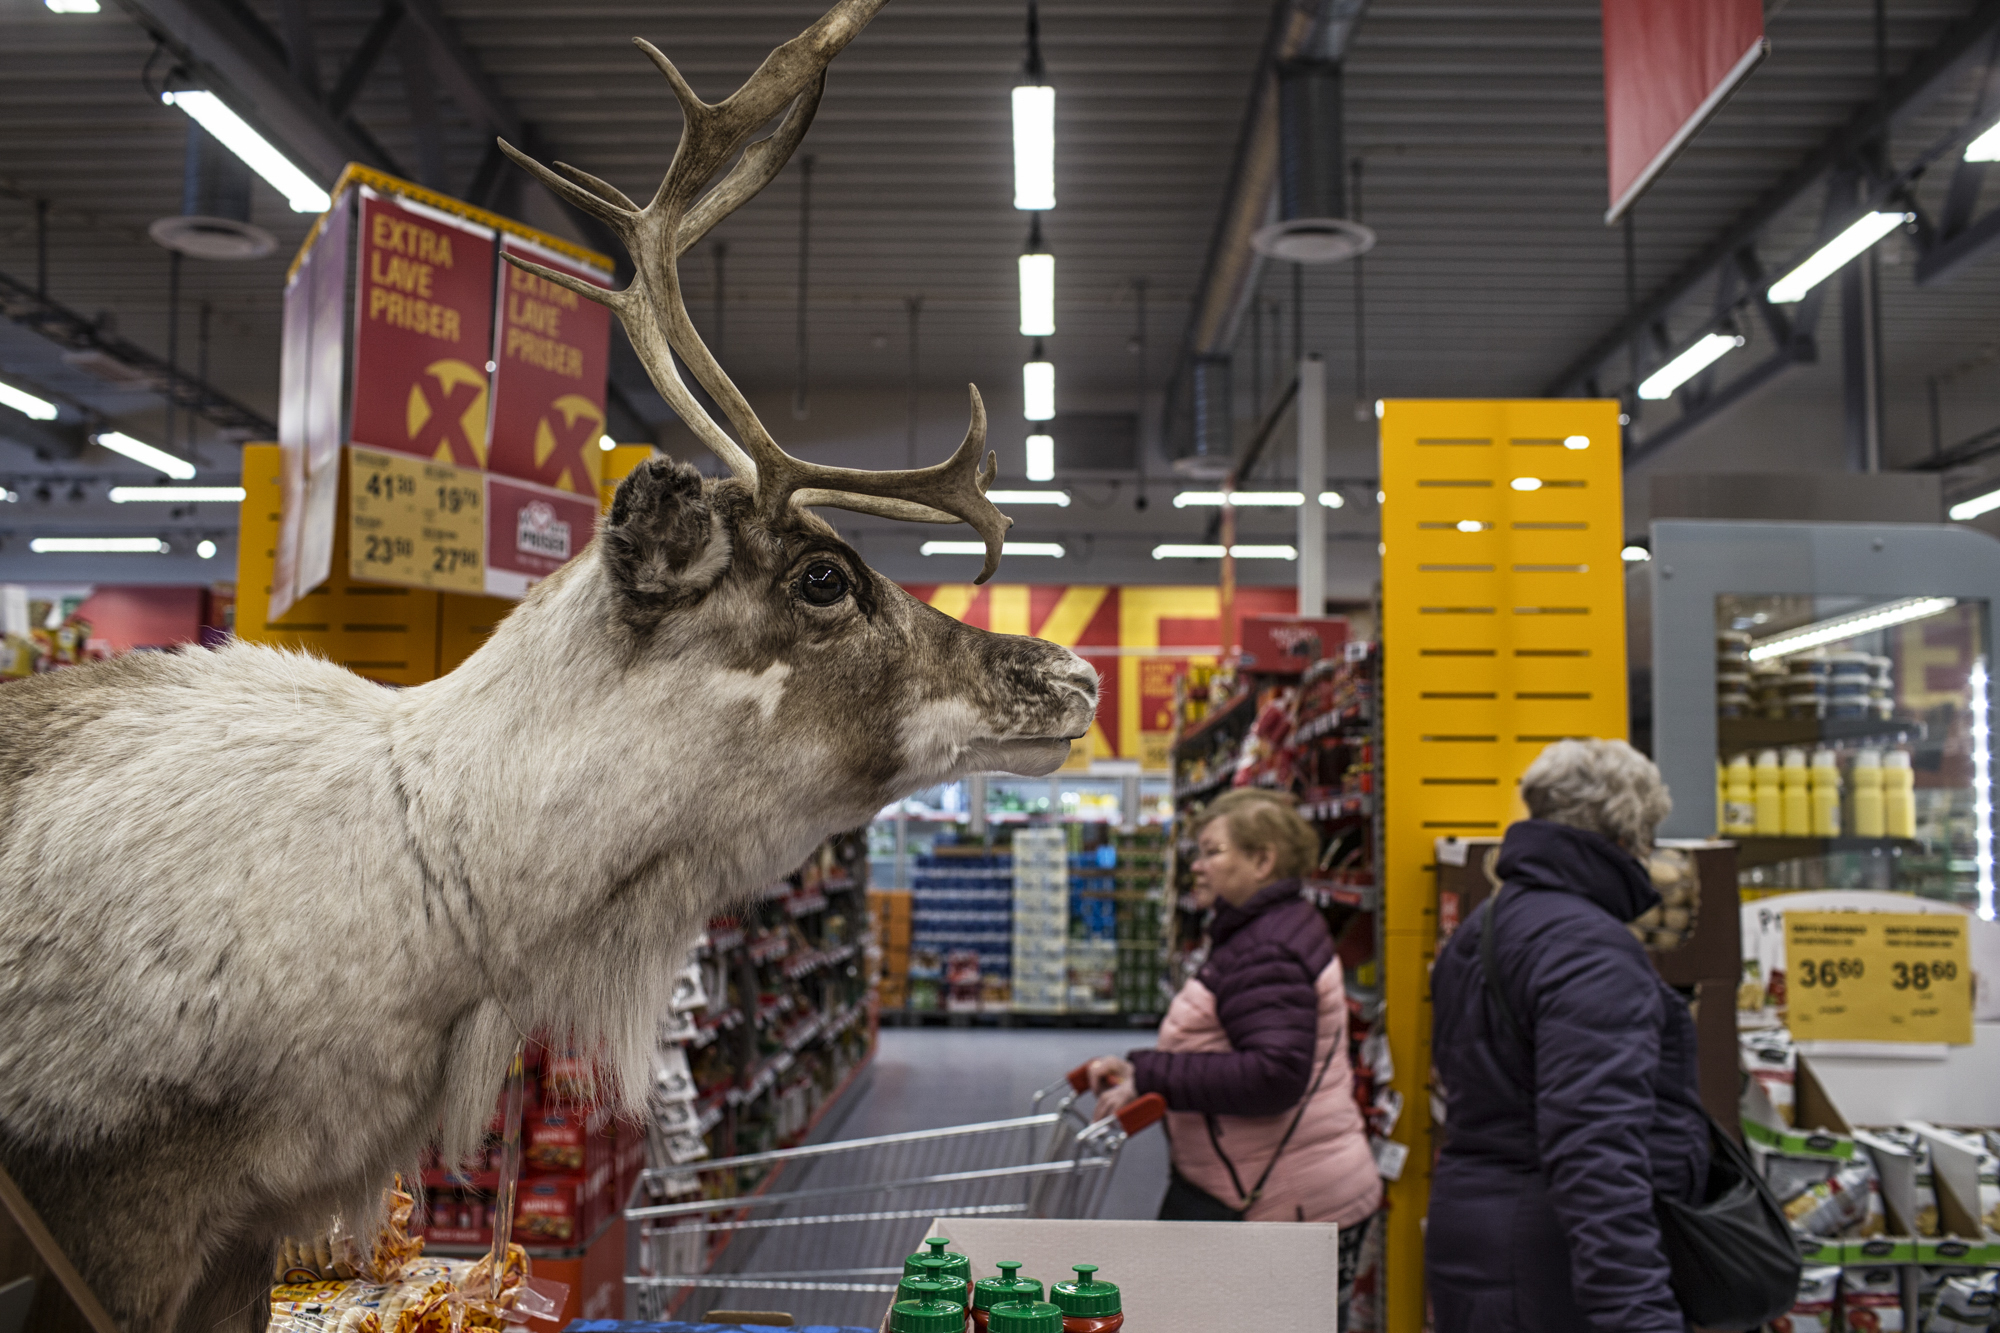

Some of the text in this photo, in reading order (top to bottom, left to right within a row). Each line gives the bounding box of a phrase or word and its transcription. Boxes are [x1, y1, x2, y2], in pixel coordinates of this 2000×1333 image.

[373, 213, 453, 270] EXTRA
[371, 249, 434, 298] LAVE
[370, 287, 460, 343] PRISER
[508, 293, 561, 339] LAVE
[506, 327, 583, 378] PRISER
[521, 530, 567, 553] PRISER
